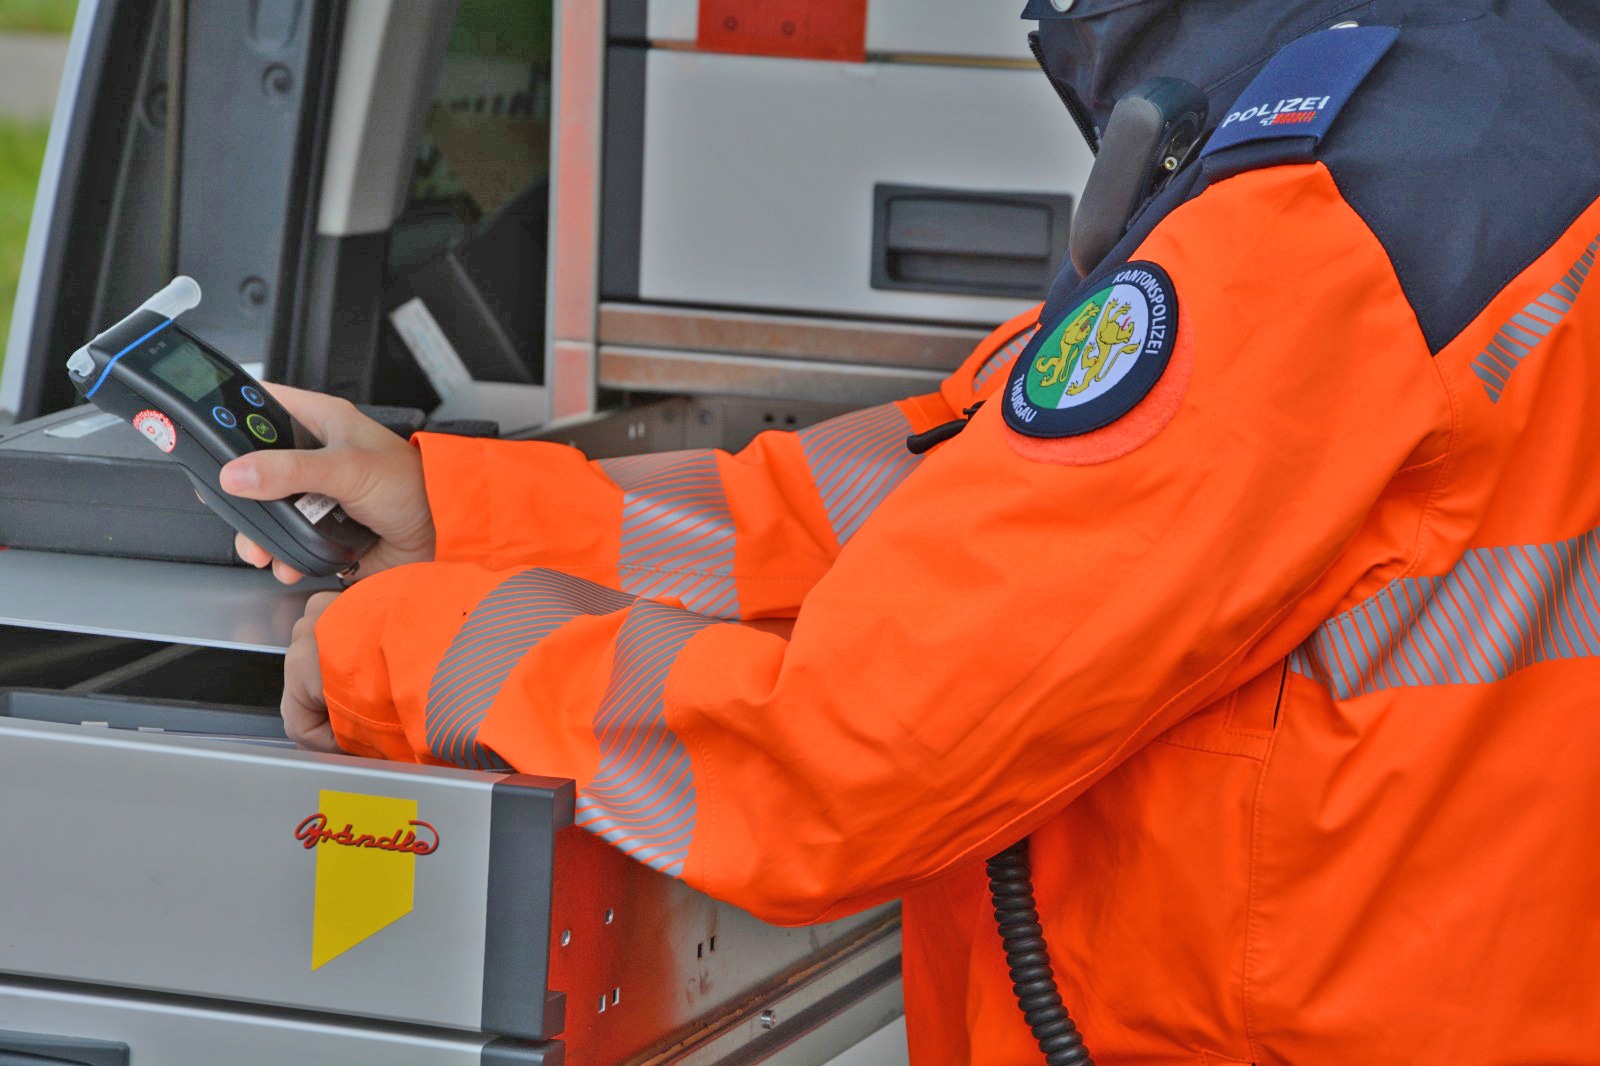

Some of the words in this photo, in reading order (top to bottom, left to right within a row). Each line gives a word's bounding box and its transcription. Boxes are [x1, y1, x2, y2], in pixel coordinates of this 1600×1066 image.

[1222, 96, 1331, 128] POLIZEI
[1112, 270, 1167, 355] KANTONSPOLIZEI
[1011, 374, 1037, 423] THURGAU
